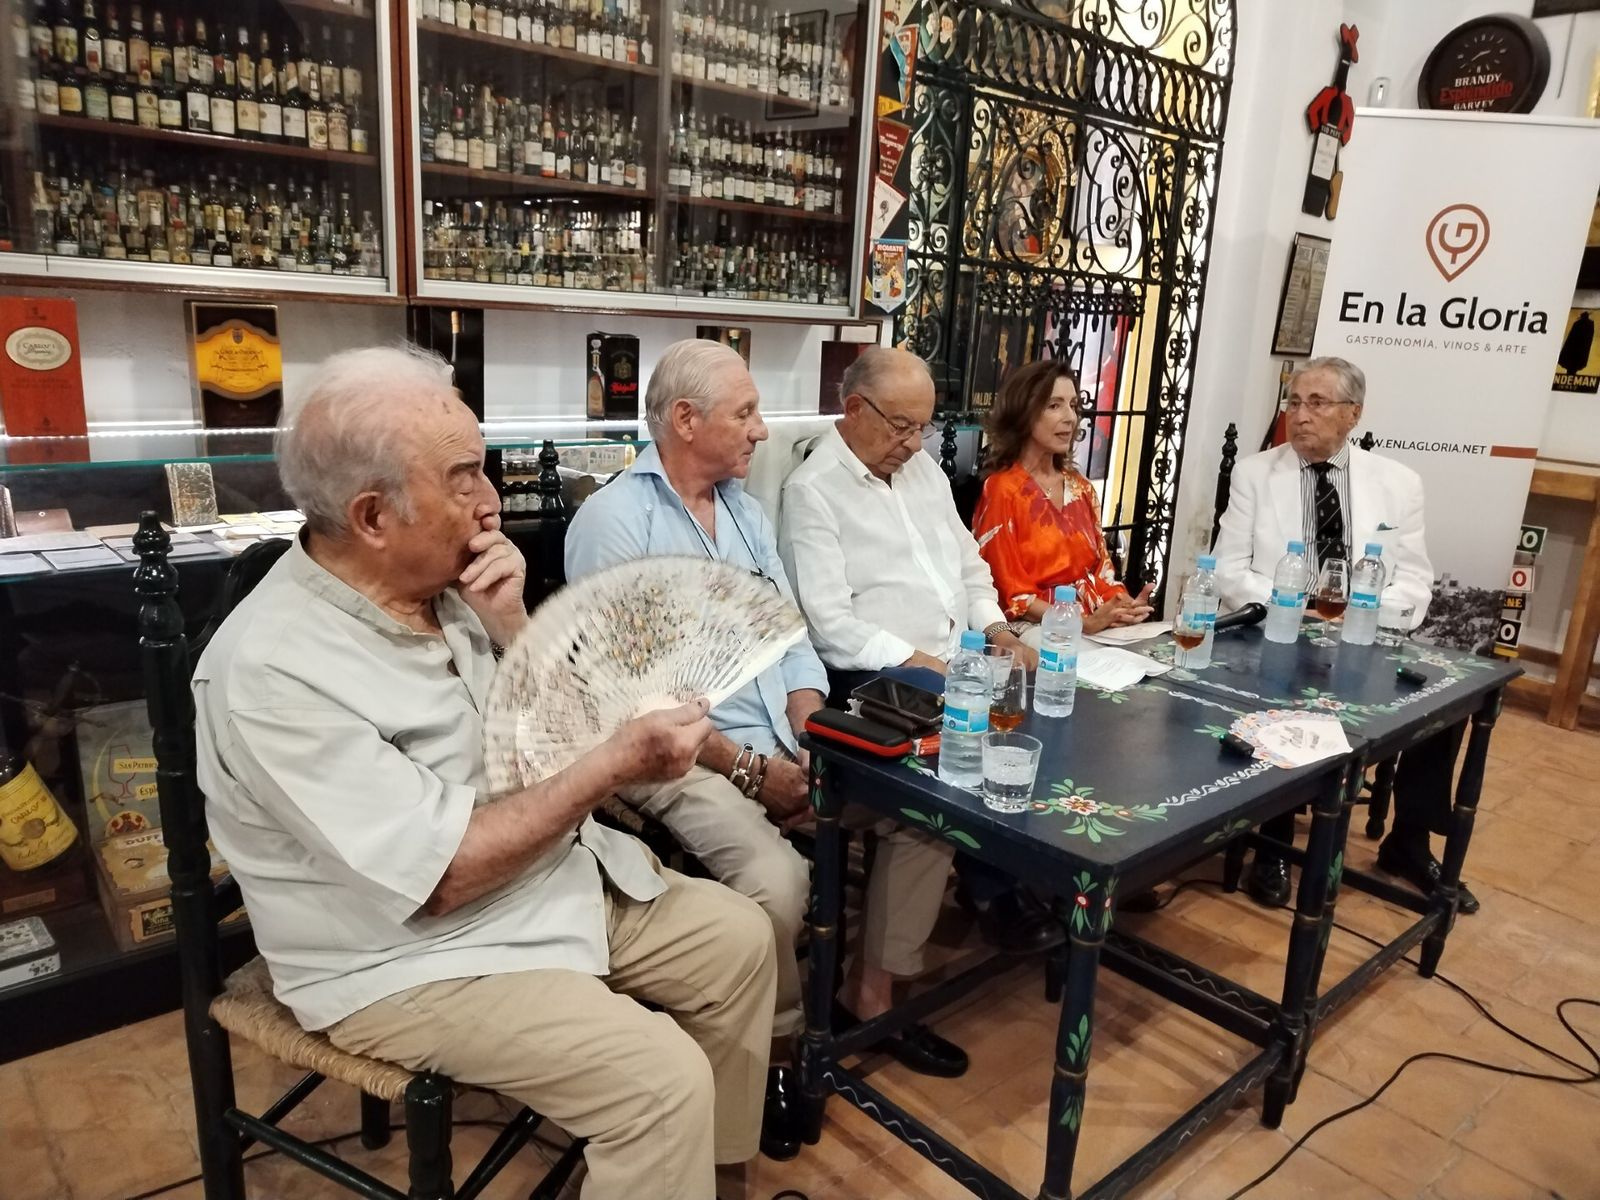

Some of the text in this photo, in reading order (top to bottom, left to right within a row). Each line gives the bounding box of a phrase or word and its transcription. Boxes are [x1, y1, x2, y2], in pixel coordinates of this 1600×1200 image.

[1454, 73, 1502, 88] BRANDY
[1453, 99, 1495, 111] GARVEY
[1339, 291, 1549, 334] En la Gloria
[1443, 340, 1480, 351] VINOS
[1484, 343, 1491, 352] &
[1496, 344, 1528, 354] ARTE
[1553, 374, 1598, 387] NDEMAN
[971, 391, 997, 406] VALDE
[1347, 436, 1487, 455] WW.ENLAGLORIA.NET
[140, 784, 157, 797] Espl
